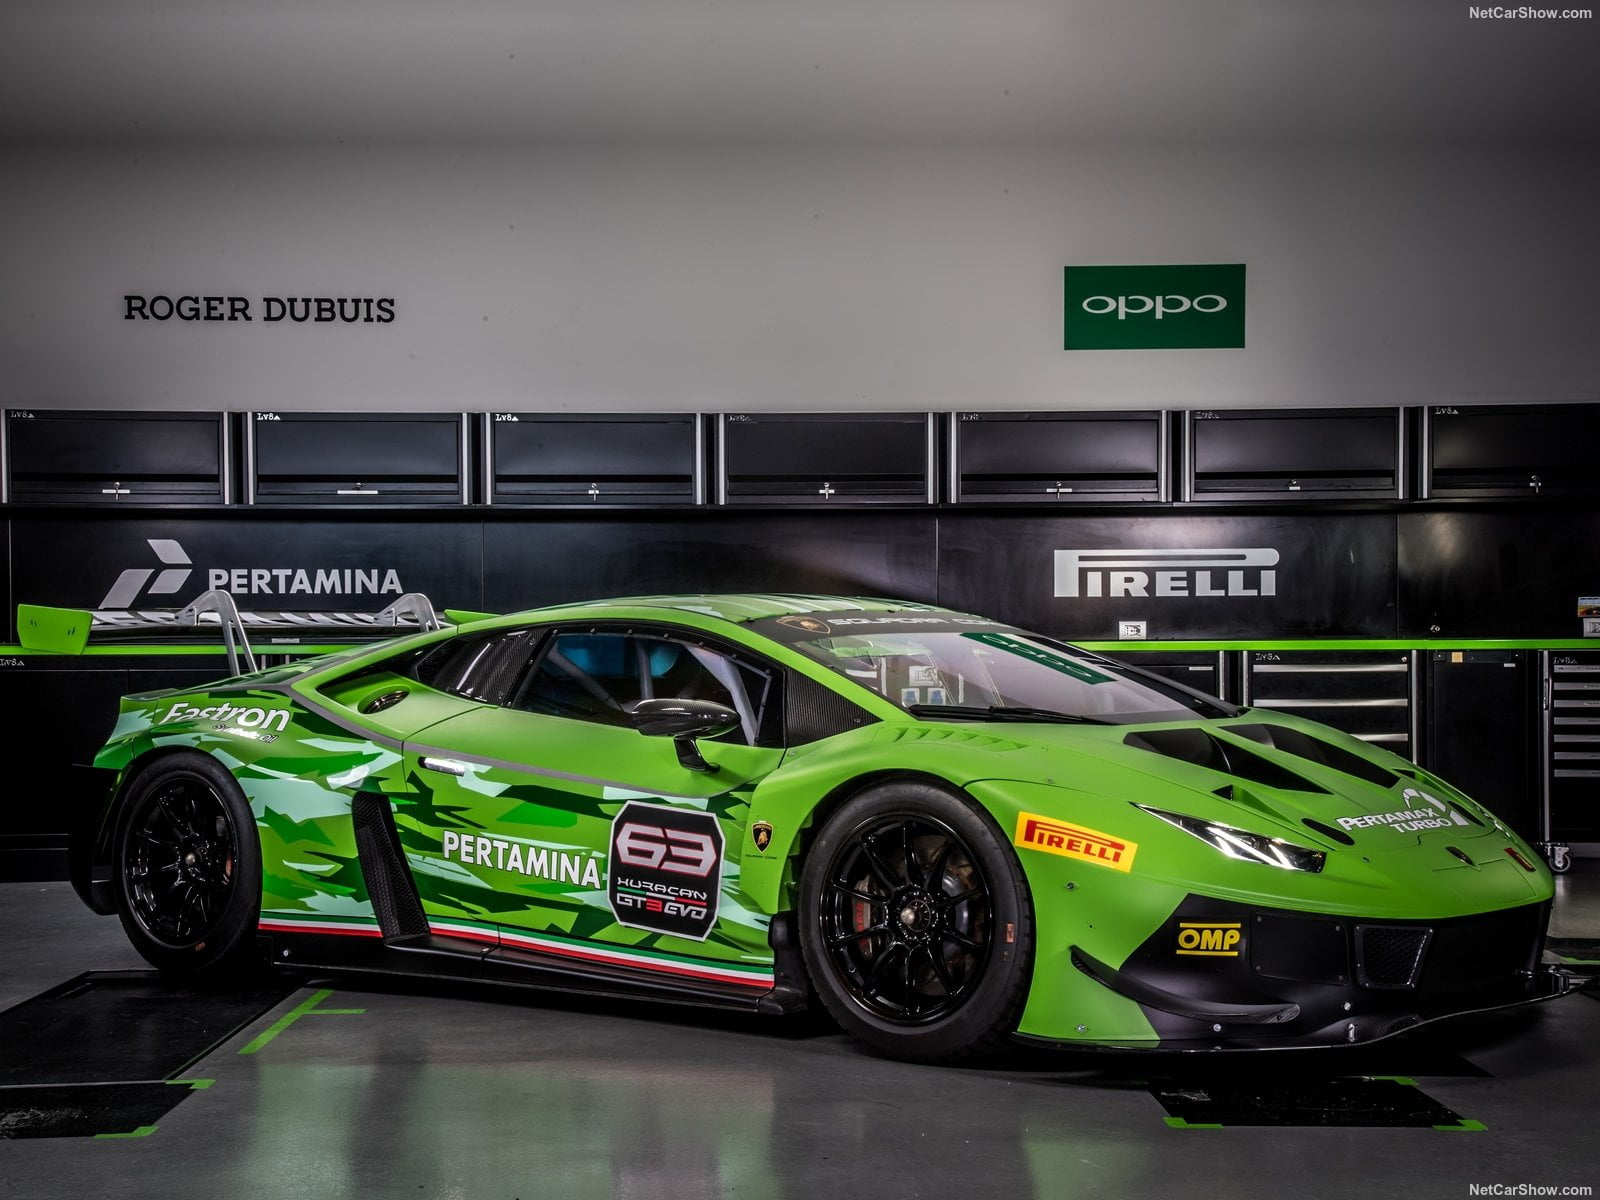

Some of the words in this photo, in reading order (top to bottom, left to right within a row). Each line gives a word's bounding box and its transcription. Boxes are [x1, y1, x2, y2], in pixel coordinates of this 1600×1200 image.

[124, 295, 253, 322] ROGER
[262, 297, 396, 324] DUBUIS
[1082, 294, 1228, 320] oppo
[208, 568, 403, 594] PERTAMINA
[1053, 547, 1280, 598] PIRELLI
[158, 701, 291, 733] Fastron
[1336, 807, 1440, 831] PERTAMAX
[1389, 817, 1453, 833] TURBO
[616, 821, 717, 878] 63
[1024, 818, 1126, 864] PIRELLI
[443, 829, 602, 890] PERTAMINA
[616, 892, 663, 913] GT3
[663, 901, 708, 921] EVO
[1178, 928, 1241, 951] OMP
